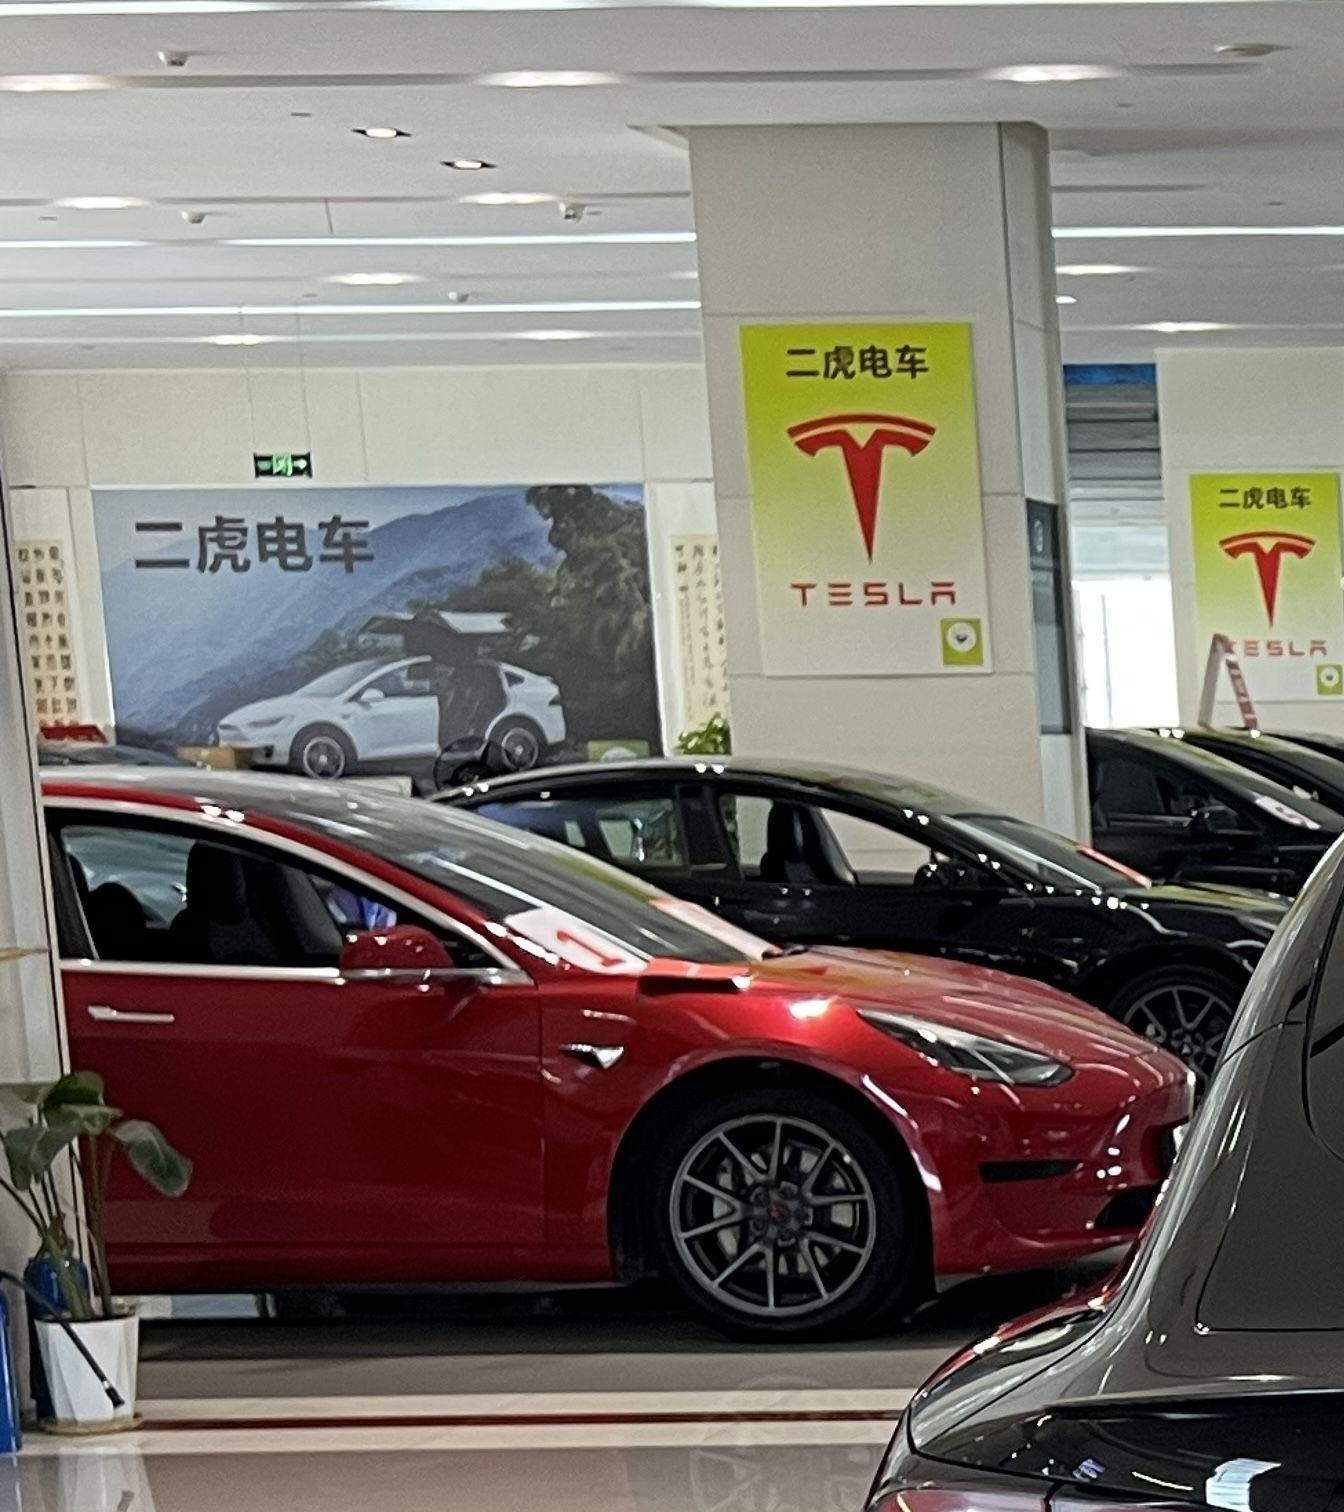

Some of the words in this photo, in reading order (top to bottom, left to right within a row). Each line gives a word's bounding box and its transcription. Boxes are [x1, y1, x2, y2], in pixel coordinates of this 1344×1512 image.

[786, 344, 930, 380] 二虎电车
[1218, 486, 1313, 510] 二虎电车
[134, 514, 375, 575] 二虎电车
[790, 581, 956, 607] TESLA
[1228, 638, 1328, 656] ESLA
